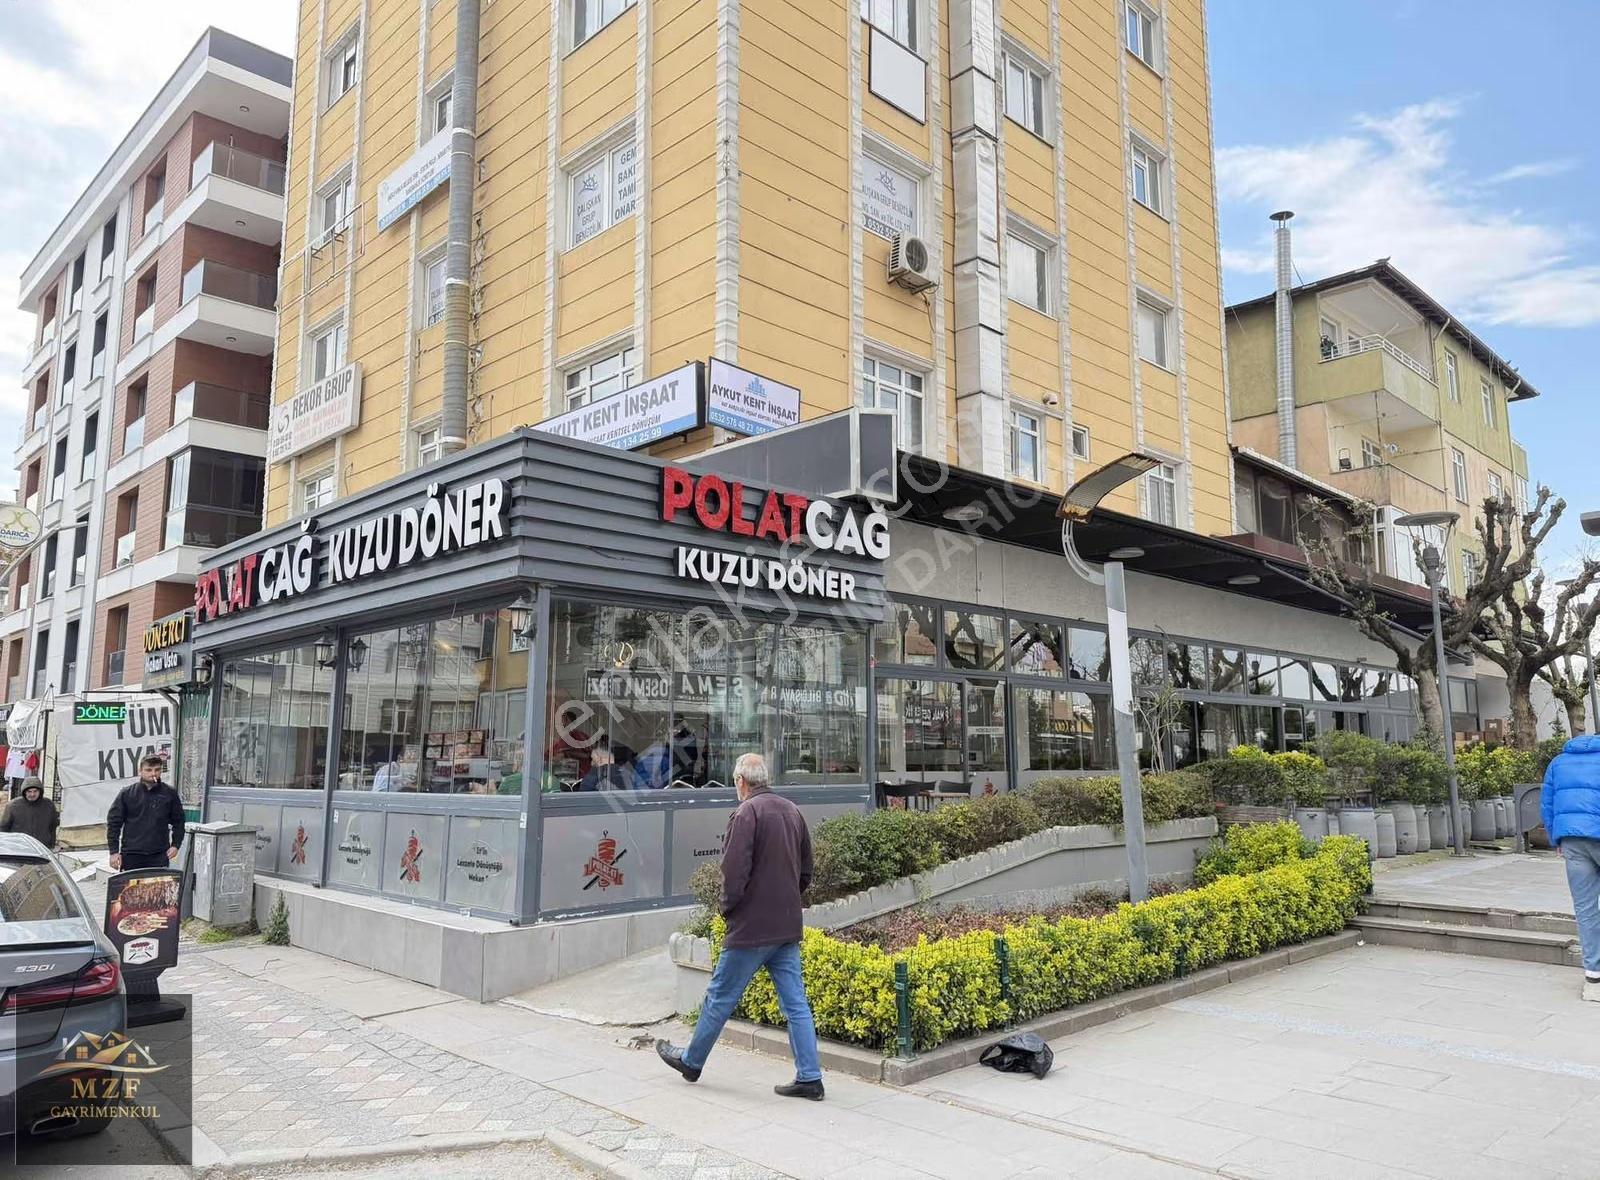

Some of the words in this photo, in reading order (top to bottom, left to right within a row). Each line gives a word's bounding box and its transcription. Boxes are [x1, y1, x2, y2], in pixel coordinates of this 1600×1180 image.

[292, 386, 323, 419] REKOR
[325, 369, 353, 402] GRUP
[583, 401, 622, 433] KENT
[625, 380, 680, 418] İNŞAAT
[711, 383, 742, 403] AYKUT
[743, 394, 767, 411] KENT
[768, 400, 798, 423] İNŞAAT
[652, 426, 662, 439] 99
[663, 466, 808, 545] POLAT
[806, 498, 890, 560] CAĞ
[194, 553, 257, 624] POLAT
[258, 517, 313, 603] CAĞ
[328, 512, 396, 584] KUZU
[398, 477, 504, 565] DÖNER
[678, 546, 759, 587] KUZU
[768, 558, 857, 601] DÖNER
[693, 848, 721, 858] Lezzete
